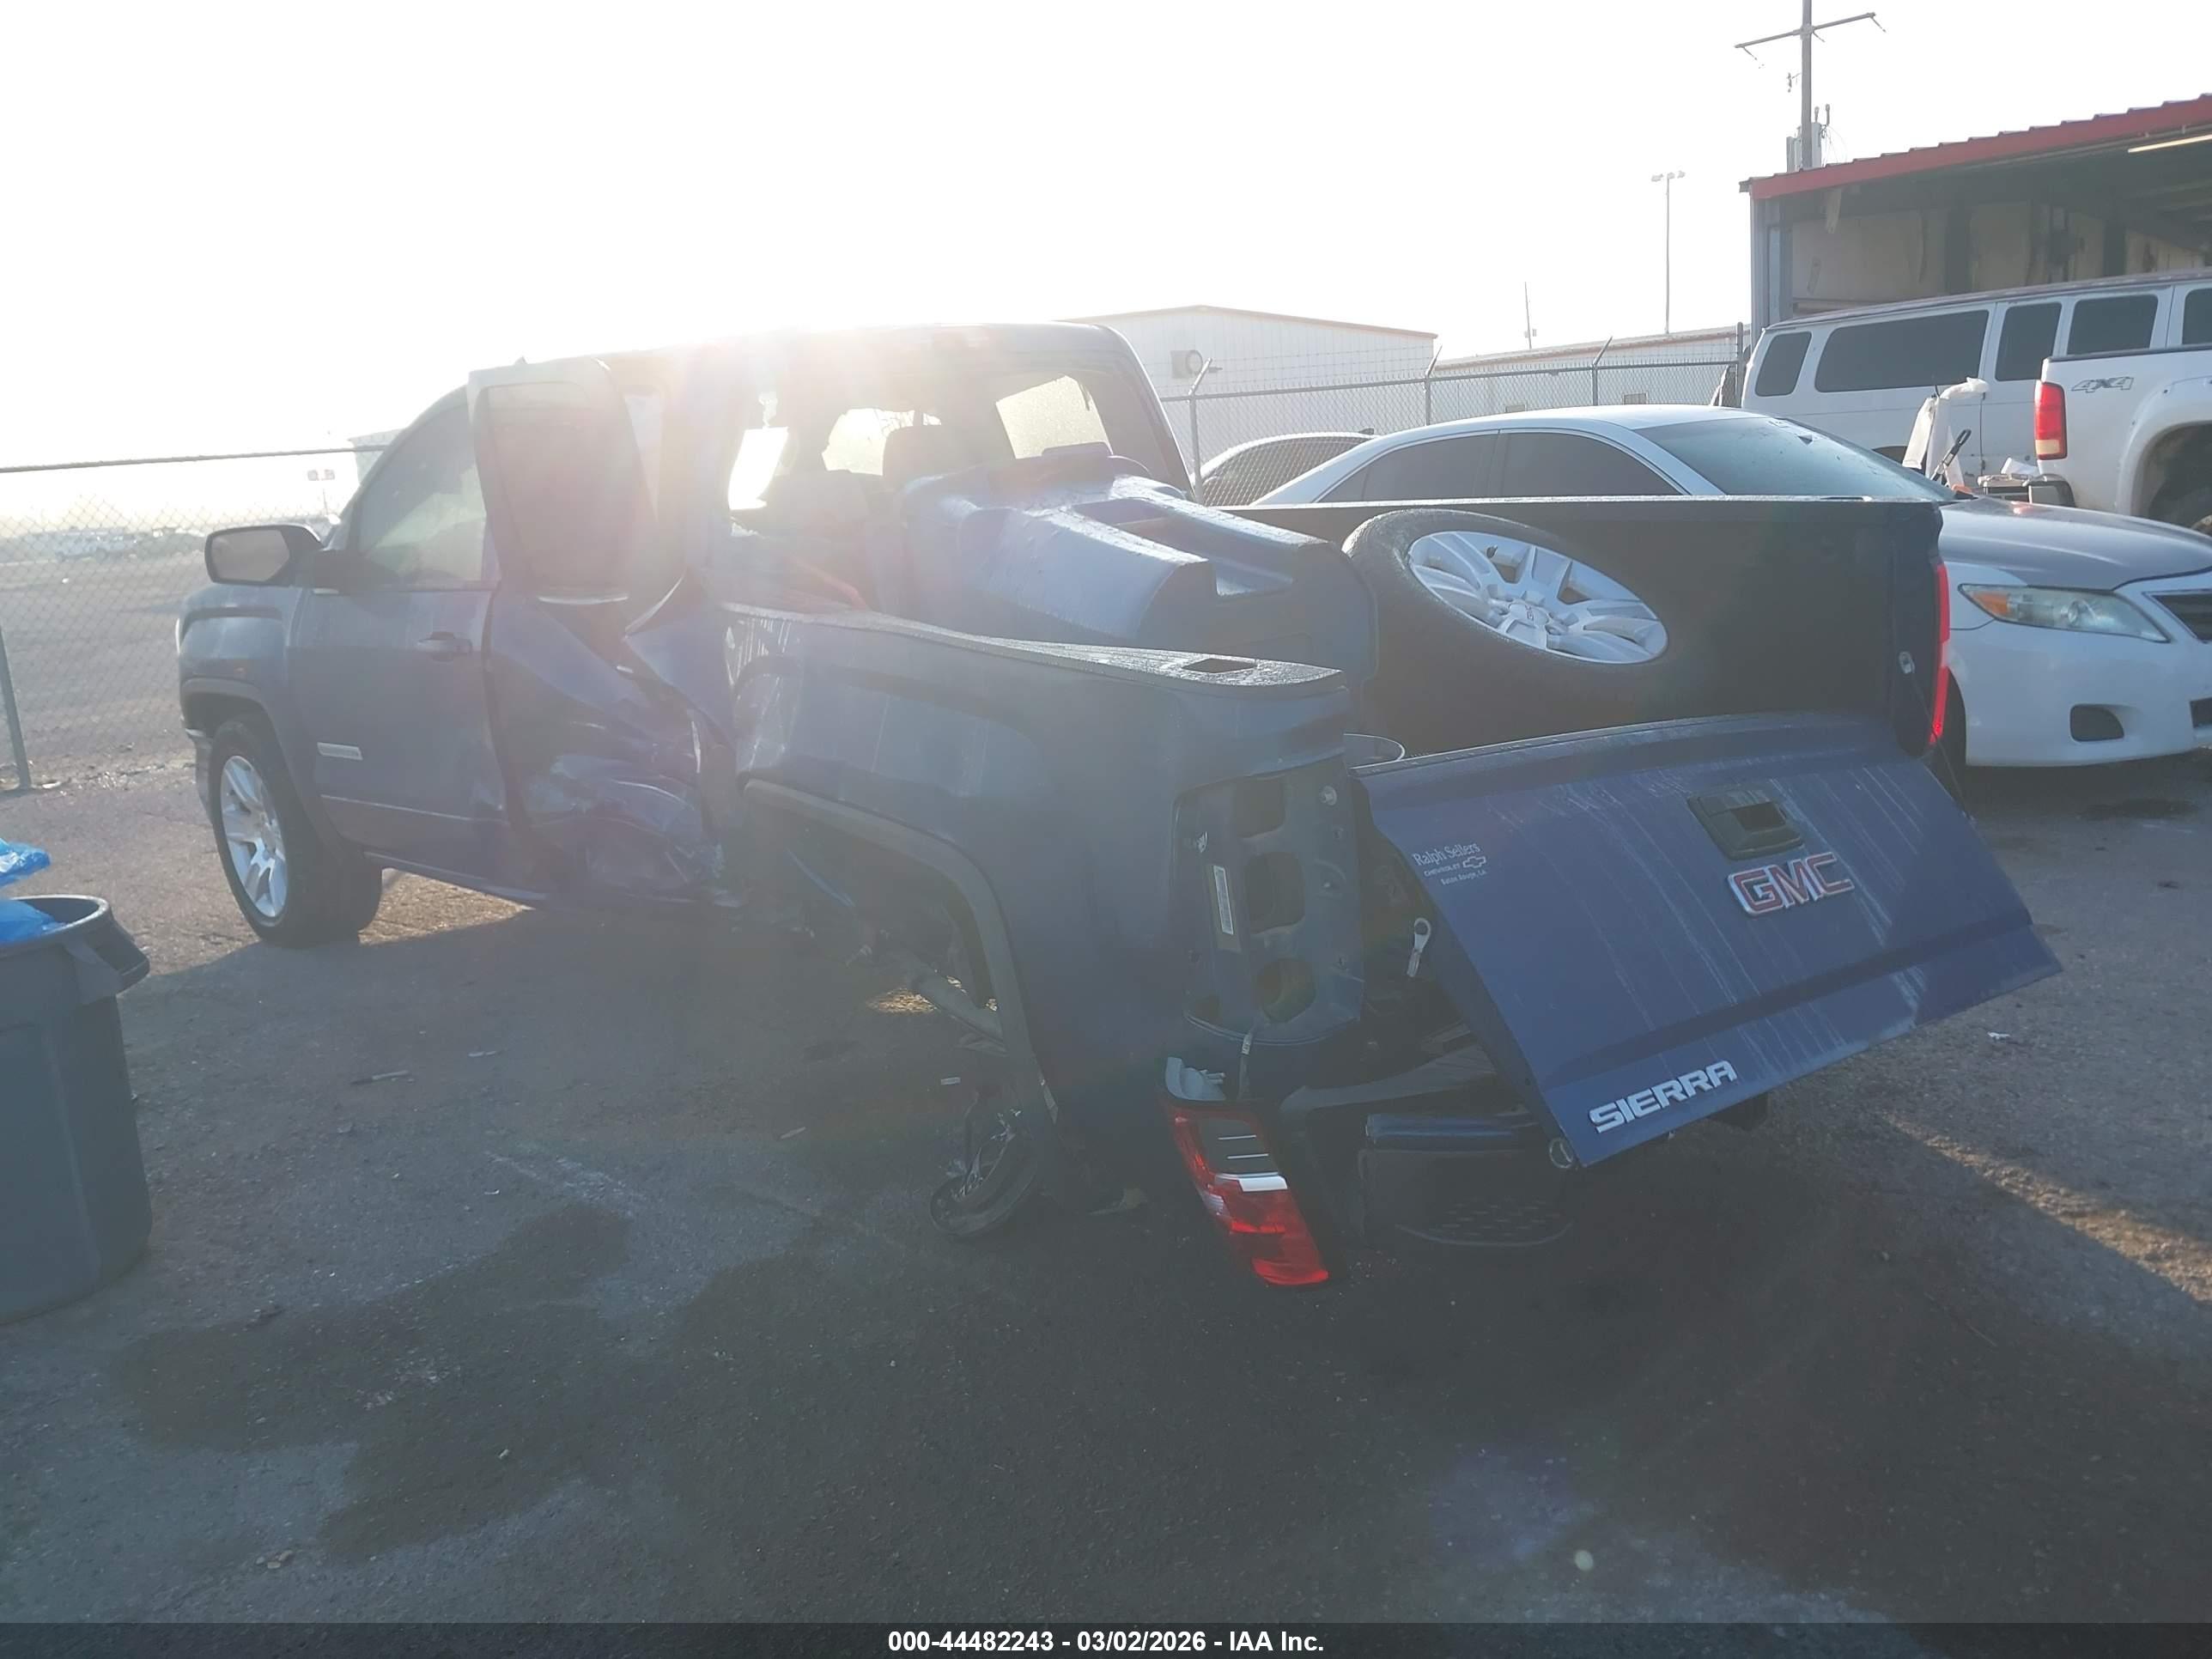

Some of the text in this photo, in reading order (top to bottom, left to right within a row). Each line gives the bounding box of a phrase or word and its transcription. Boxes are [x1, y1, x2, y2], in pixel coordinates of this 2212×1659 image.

[1411, 842, 1481, 866] Ralph Sellers
[1727, 851, 1855, 916] GMC
[1589, 1060, 1738, 1133] SIERRA
